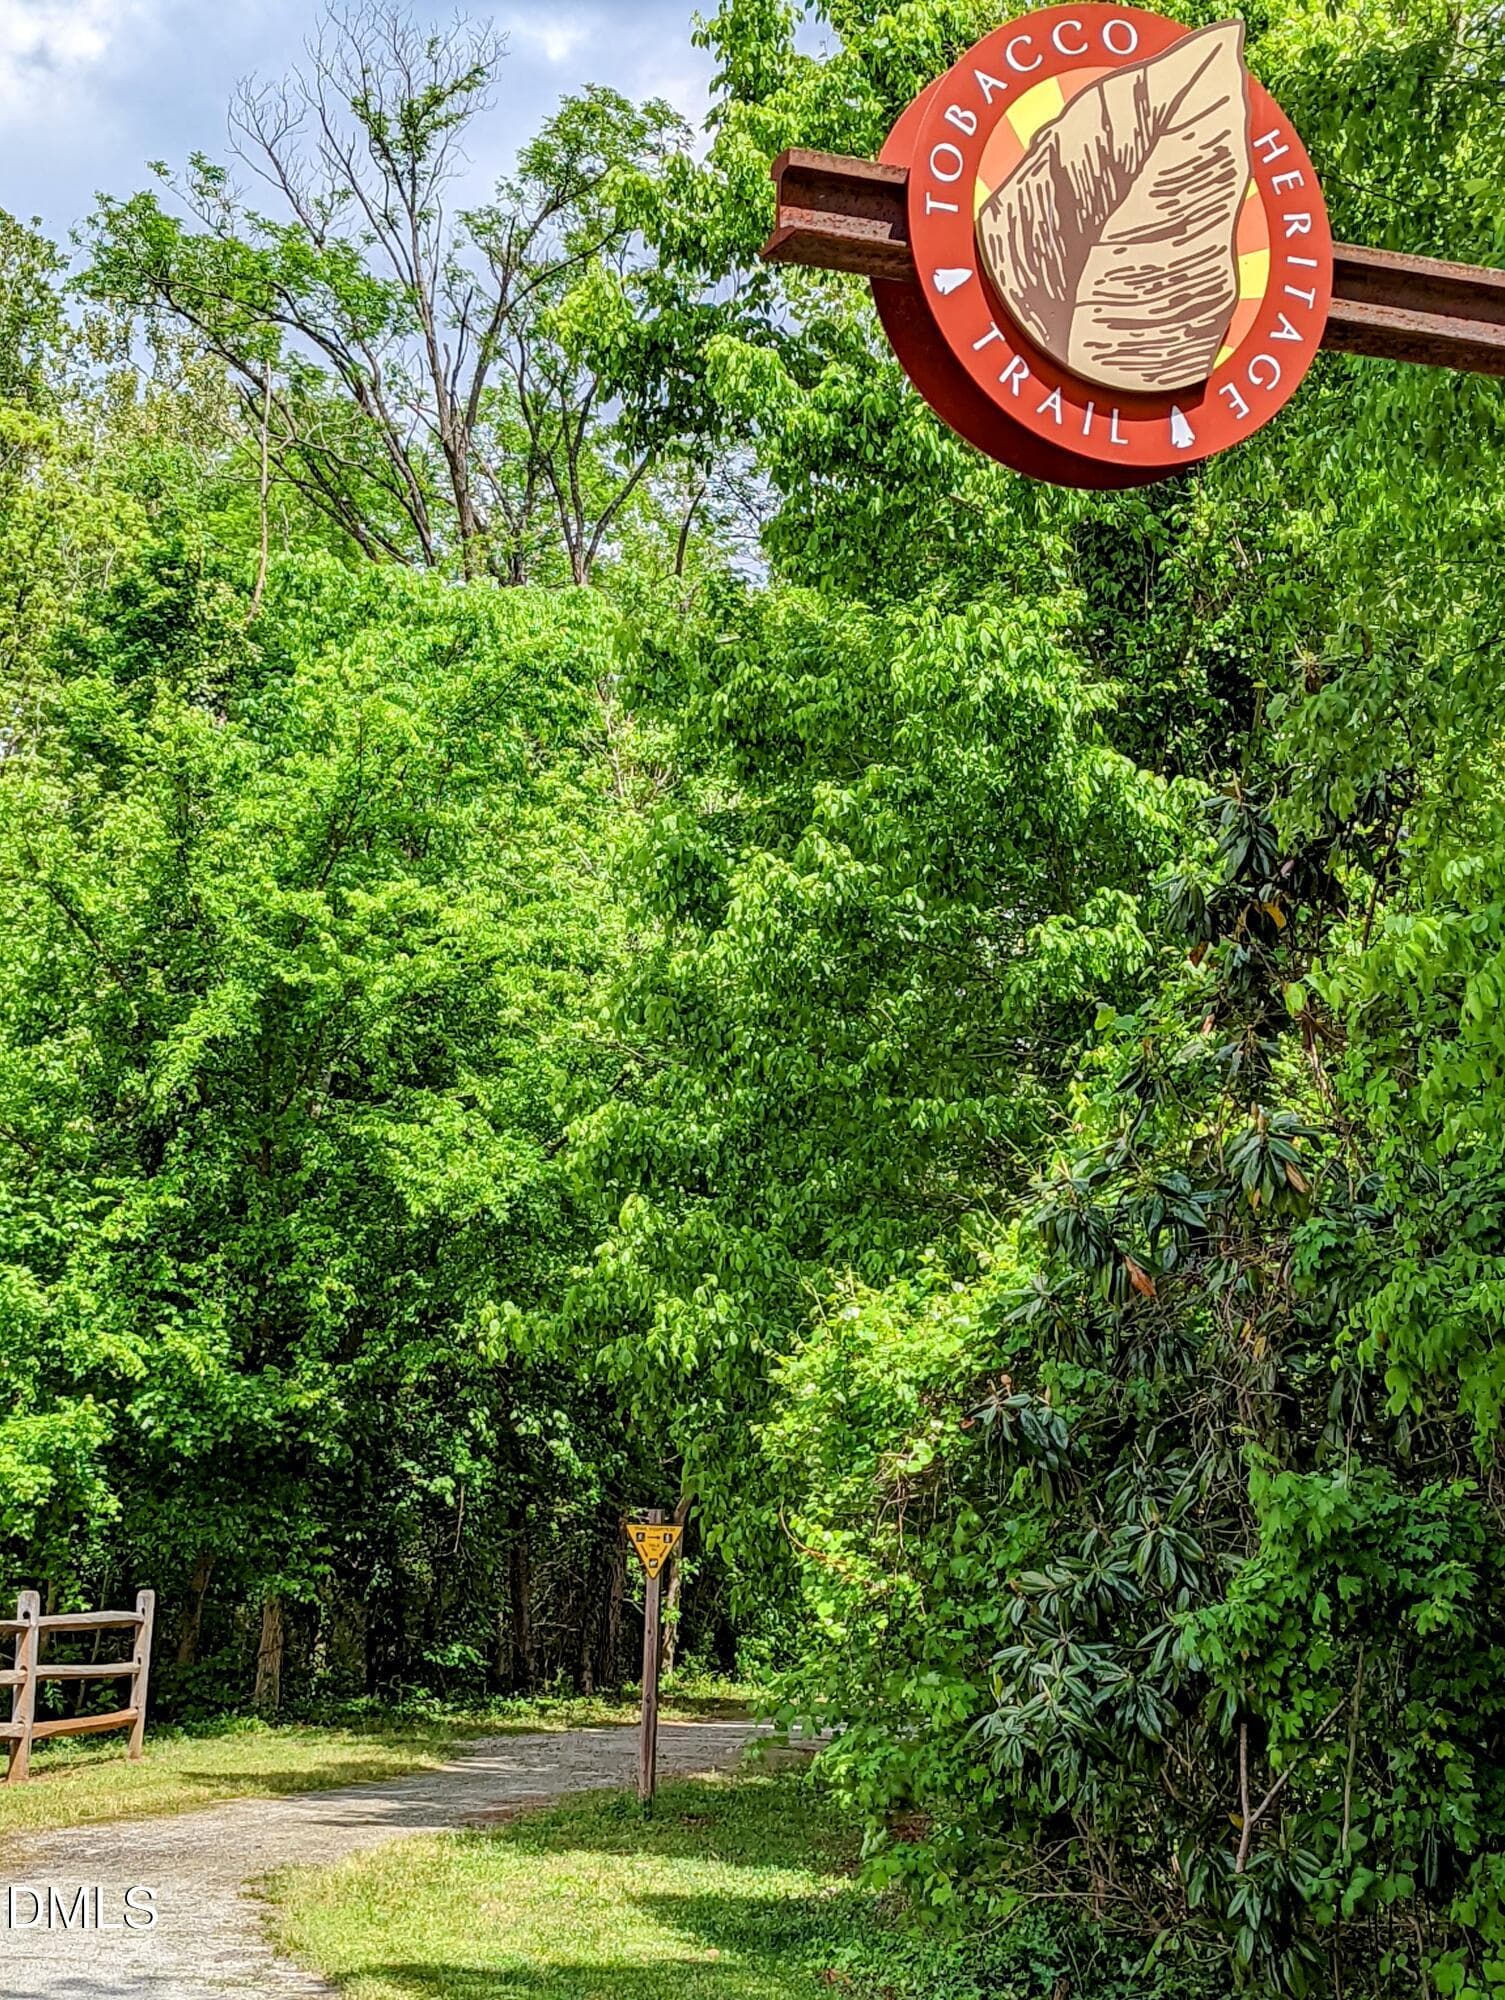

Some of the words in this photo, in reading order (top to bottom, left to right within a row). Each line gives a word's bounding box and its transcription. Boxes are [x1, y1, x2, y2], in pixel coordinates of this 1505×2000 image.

[926, 18, 1139, 215] TOBACCO
[1218, 128, 1318, 420] HERITAGE
[973, 321, 1129, 446] TRAIL
